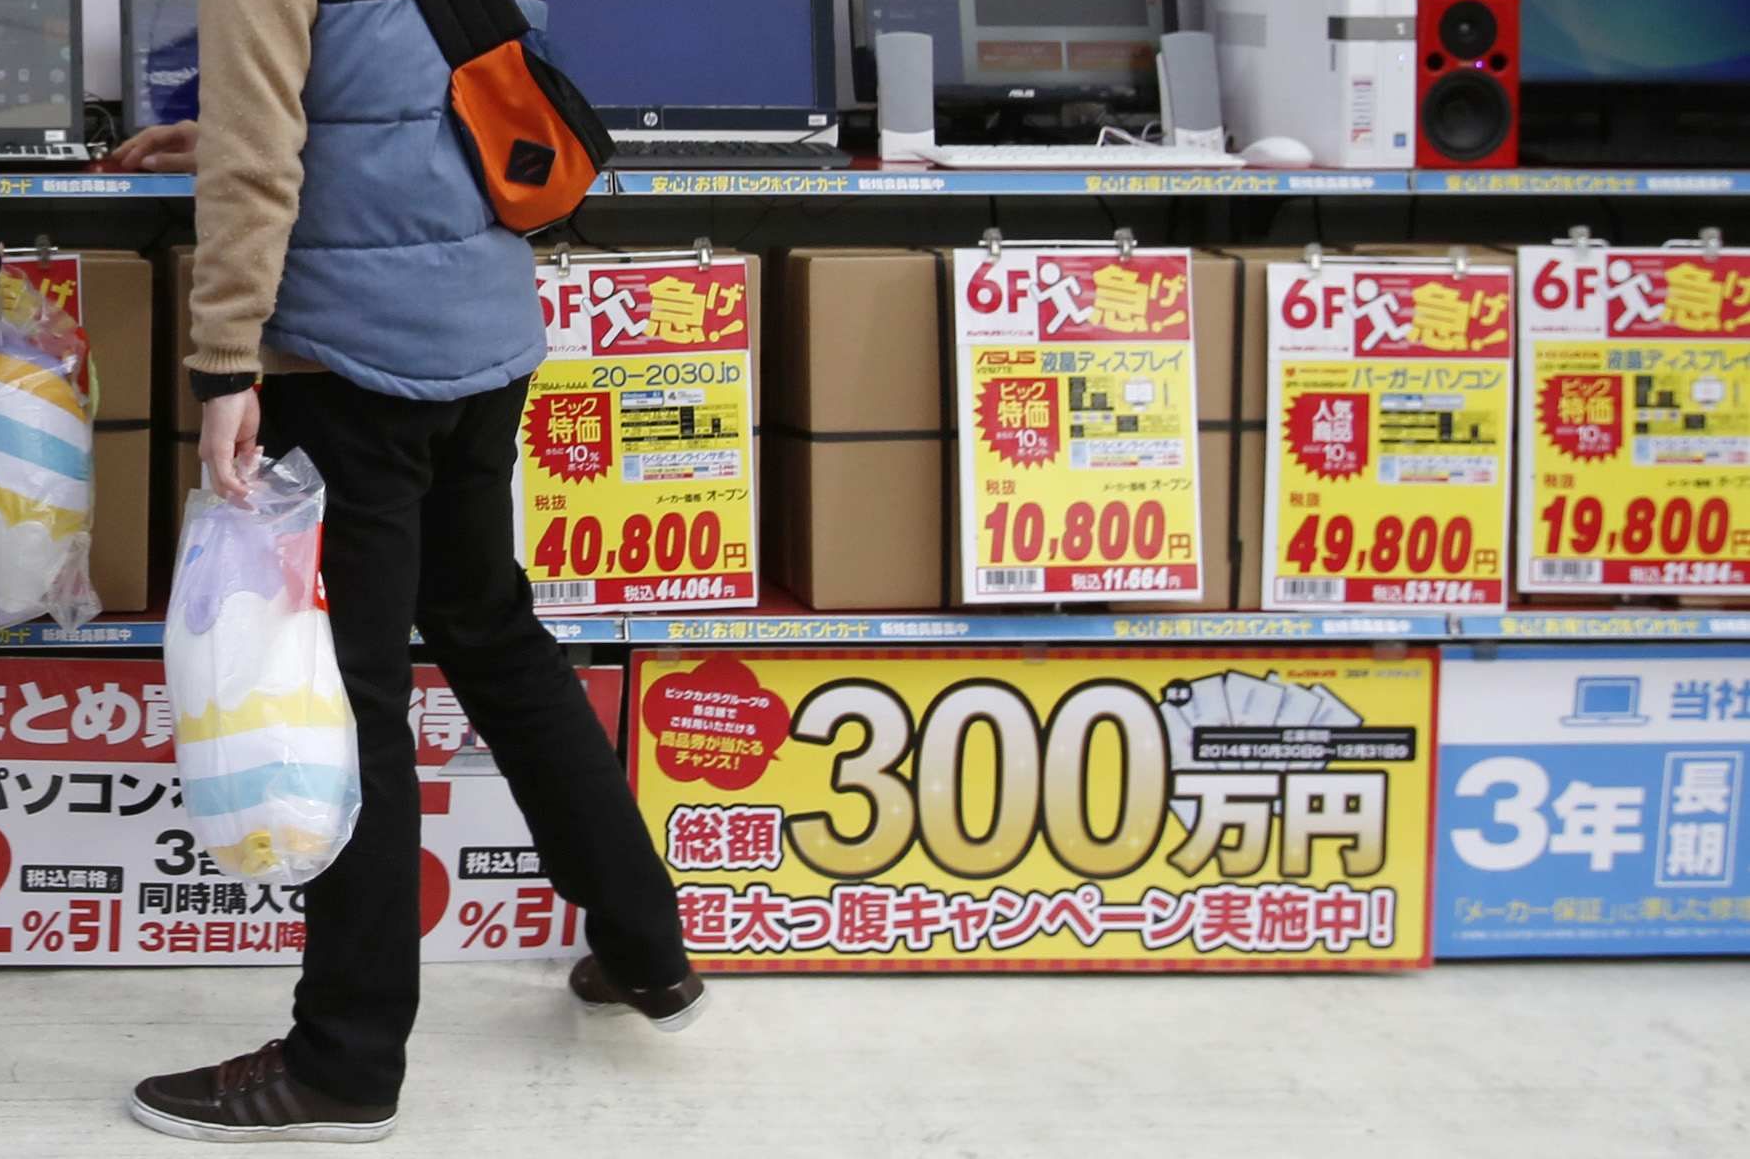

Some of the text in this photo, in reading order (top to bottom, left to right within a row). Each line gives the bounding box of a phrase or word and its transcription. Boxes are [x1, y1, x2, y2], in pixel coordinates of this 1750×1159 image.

[966, 260, 1188, 334] 6F 急げ!
[1533, 259, 1602, 312] 6F
[646, 274, 745, 345] 急げ!
[1281, 276, 1510, 352] 6F 急げ!
[592, 361, 741, 389] 20-2030jp
[976, 349, 1185, 374] ASUS 液晶ディスプレイ
[999, 381, 1046, 401] ビック
[1352, 367, 1503, 390] バーガーパソコン
[550, 397, 598, 416] ビック
[996, 398, 1051, 429] 特価
[1311, 398, 1353, 421] 人気
[547, 416, 602, 444] 特価
[565, 444, 599, 462] 10%
[566, 462, 600, 472] ポイント
[705, 488, 749, 502] オープン
[985, 478, 1017, 496] 税抜
[1151, 479, 1192, 492] オープン
[534, 494, 567, 511] 税抜
[533, 510, 748, 578] 40,800円
[983, 498, 1193, 564] 10,800円
[1285, 512, 1499, 577] 49,800円
[623, 576, 736, 603] 税込44,064円
[674, 751, 741, 771] チャンス!
[1449, 755, 1646, 873] 3年
[1666, 760, 1732, 877] 長期
[666, 803, 784, 872] 総額
[678, 883, 1397, 953] 超太っ腹キャンペーン実施中!
